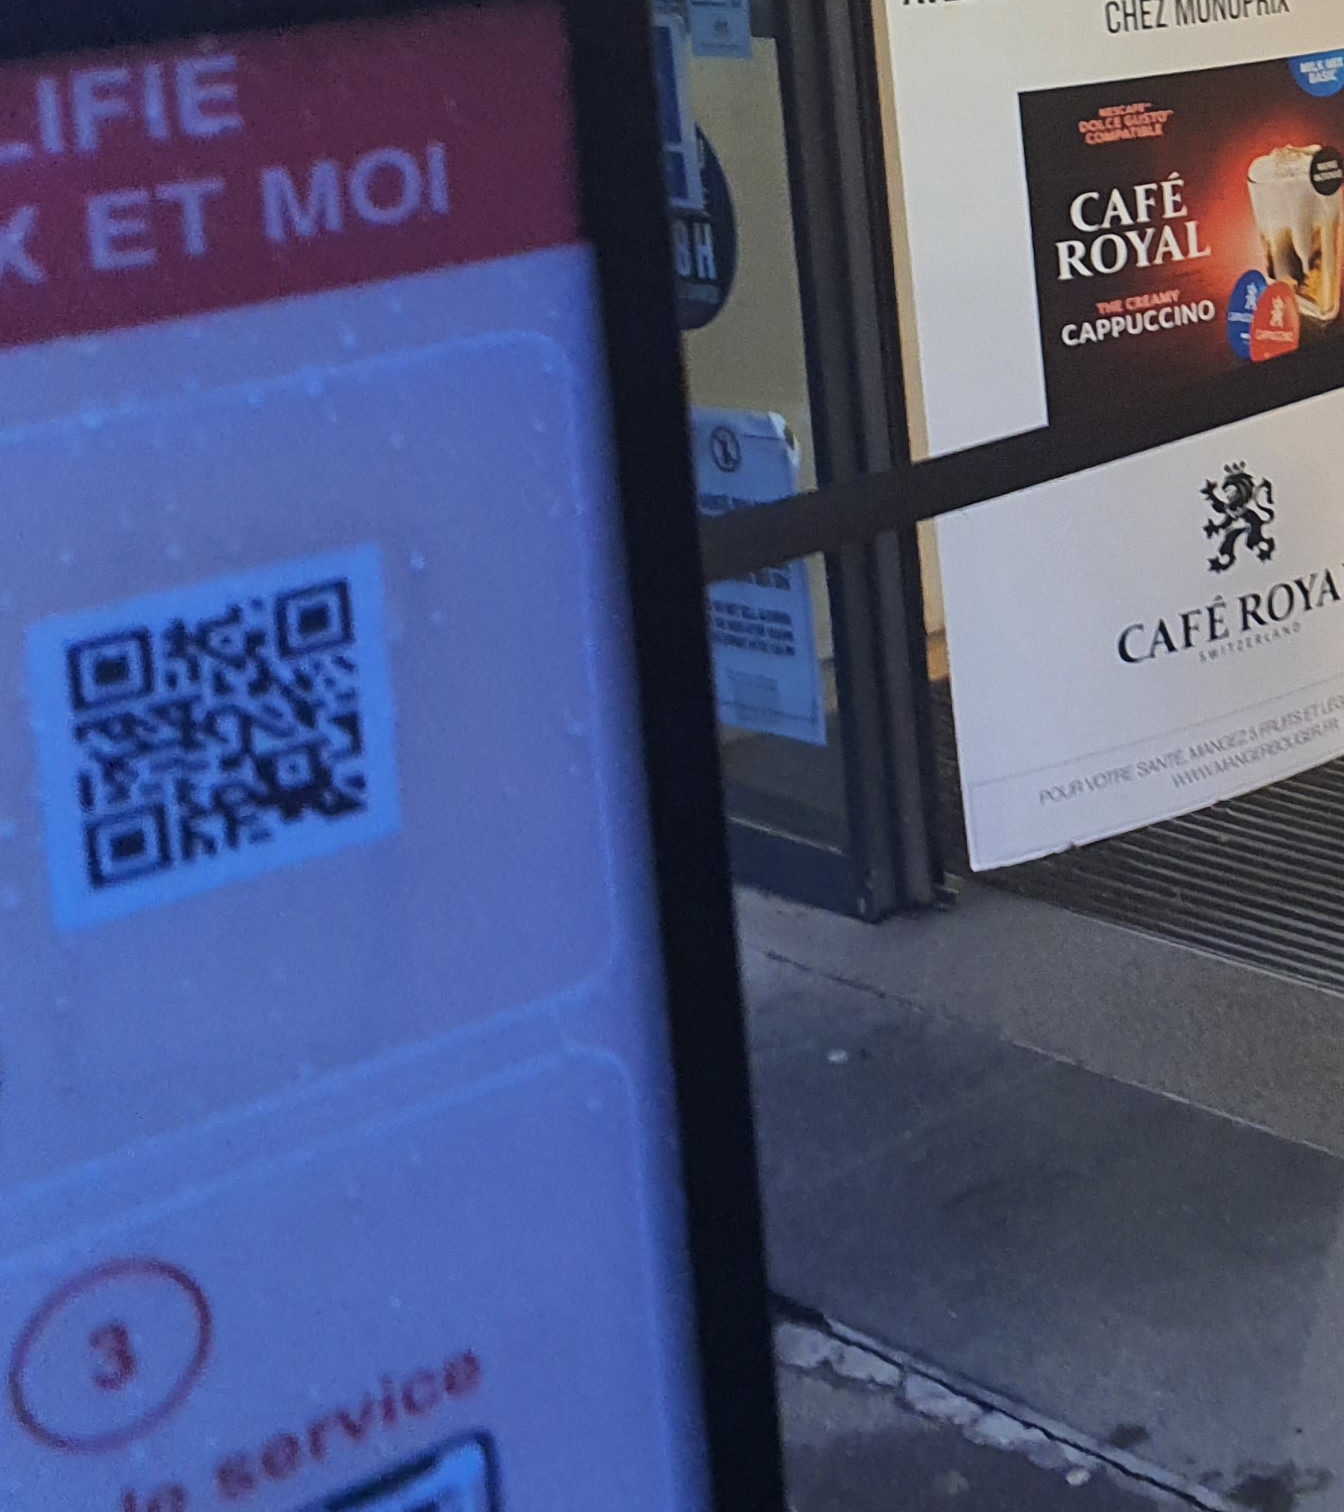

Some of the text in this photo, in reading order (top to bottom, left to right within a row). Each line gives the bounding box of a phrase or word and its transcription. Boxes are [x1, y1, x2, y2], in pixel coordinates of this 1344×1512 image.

[86, 175, 227, 272] ET
[260, 140, 451, 245] MOI
[1070, 172, 1188, 232] CAFÉ
[1055, 220, 1212, 280] ROYAL
[1061, 299, 1216, 346] CAPPUCCINO
[1126, 289, 1180, 311] CREAMY
[1117, 595, 1231, 664] CAFÉ
[1200, 620, 1302, 663] SWITZERLAND
[88, 1318, 138, 1393] 3
[215, 1346, 483, 1503] service
